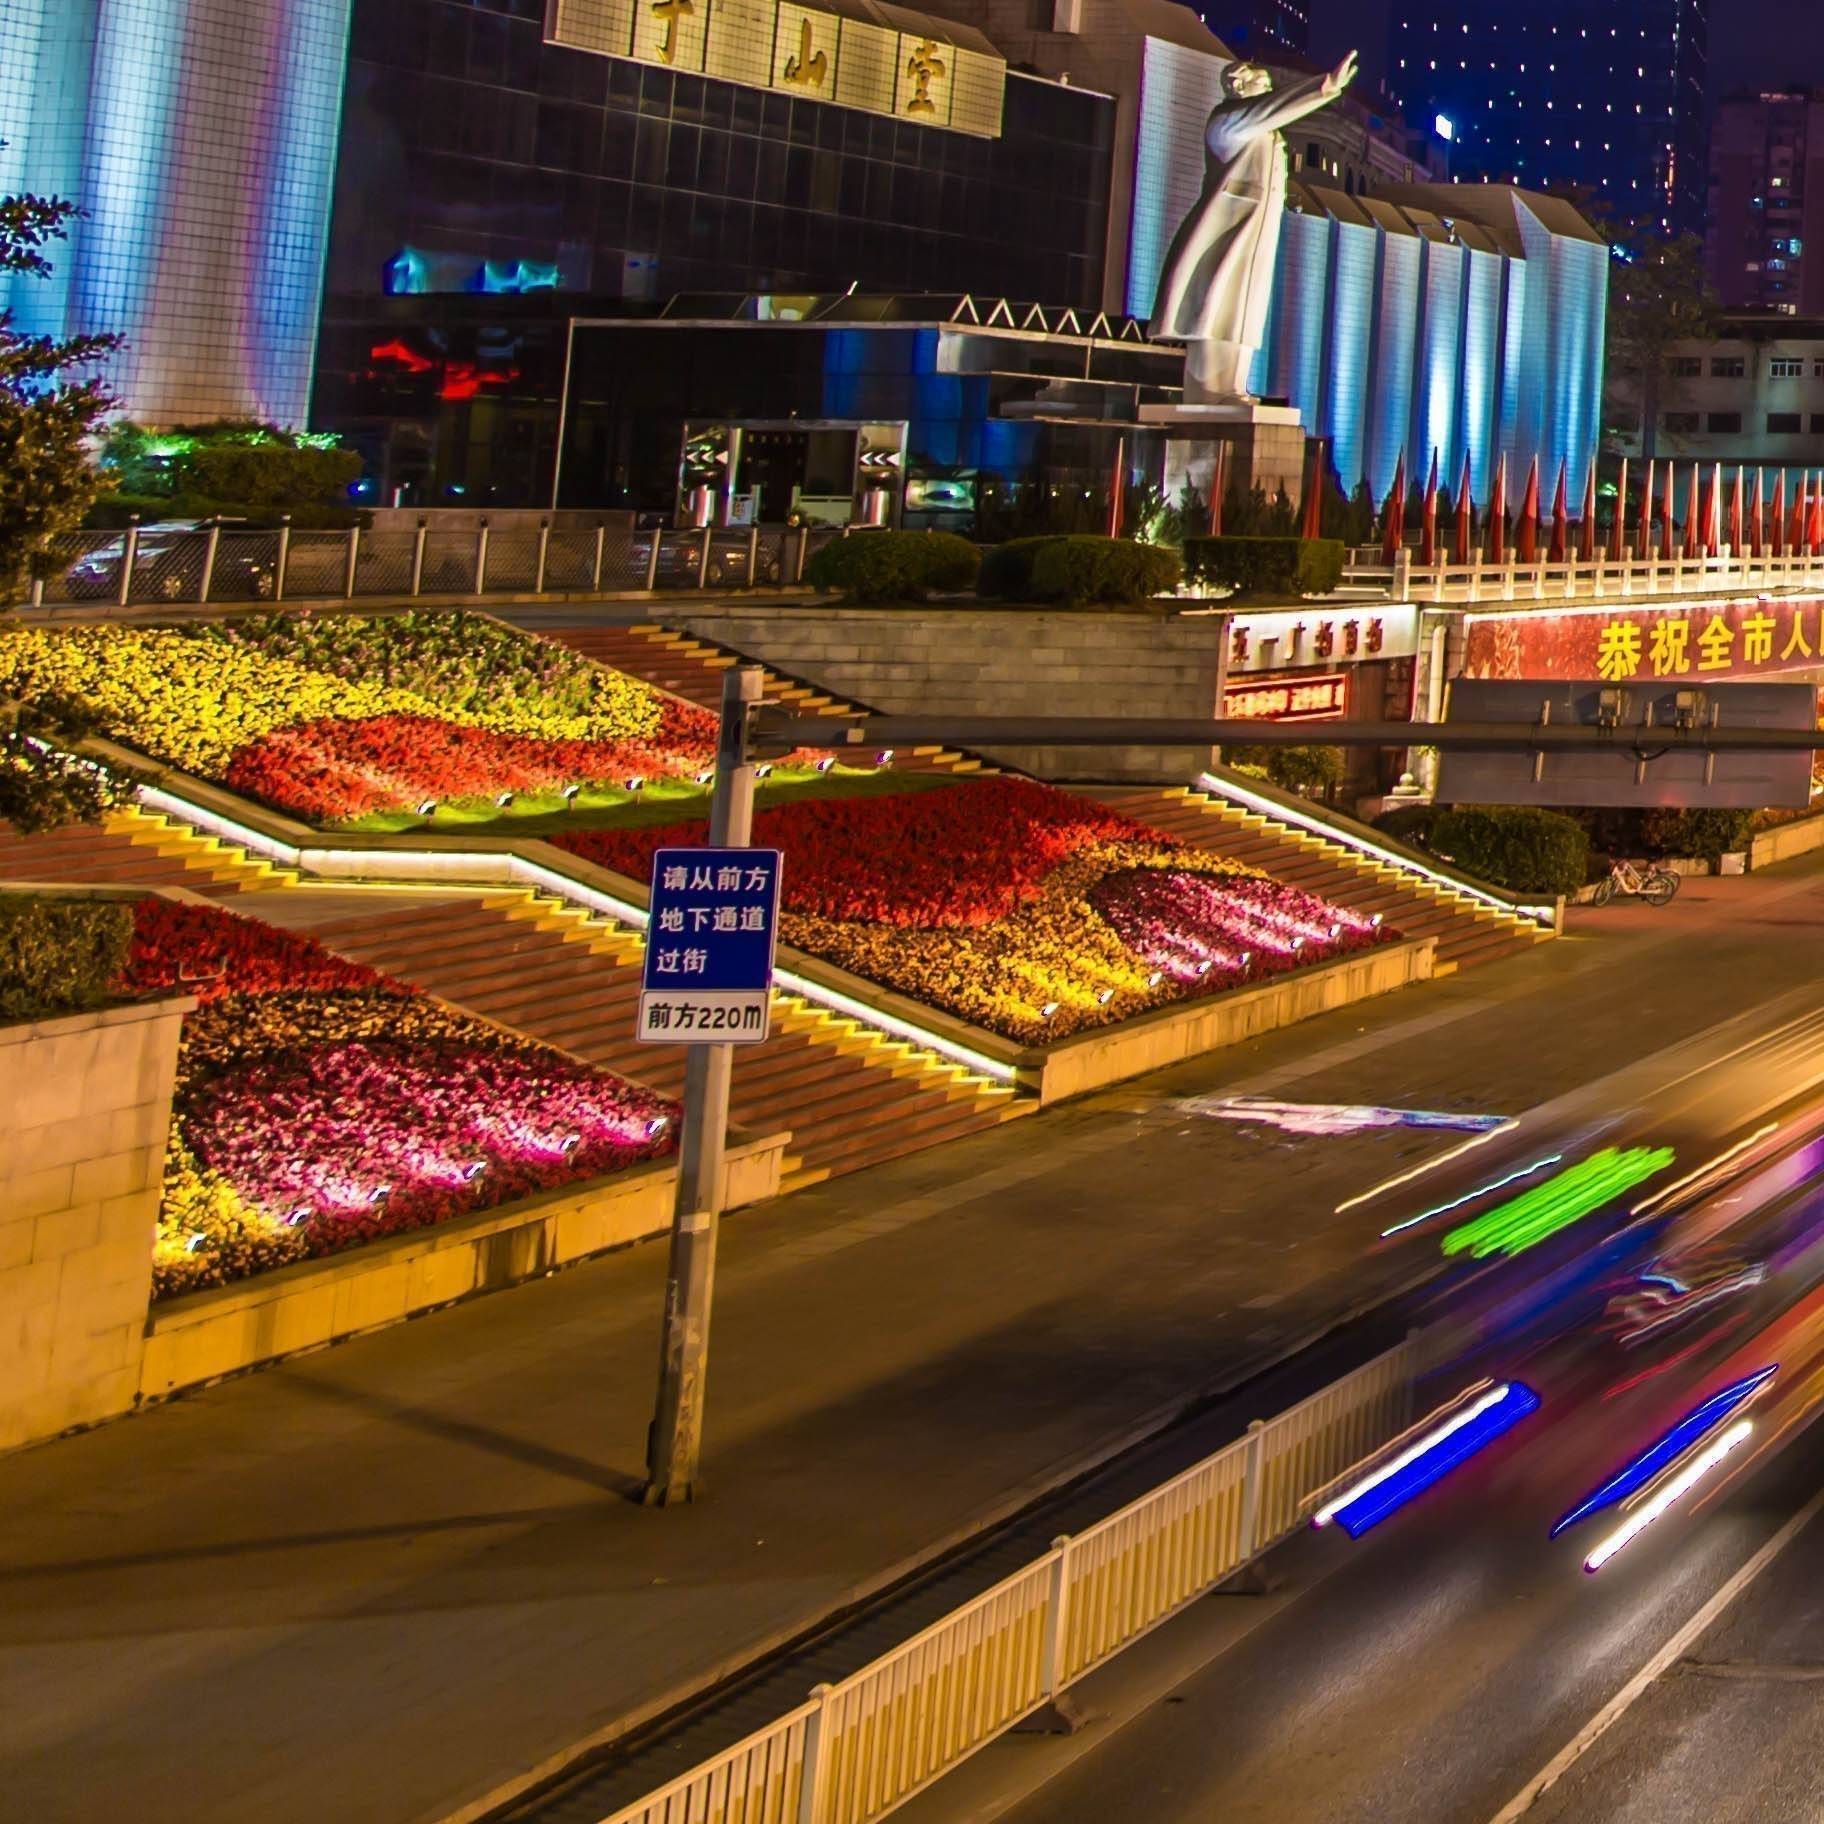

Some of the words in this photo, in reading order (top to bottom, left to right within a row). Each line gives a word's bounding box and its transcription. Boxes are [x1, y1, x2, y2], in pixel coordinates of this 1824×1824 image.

[662, 865, 770, 892] 请从前方
[658, 905, 766, 933] 地下通道
[655, 947, 708, 974] 过街
